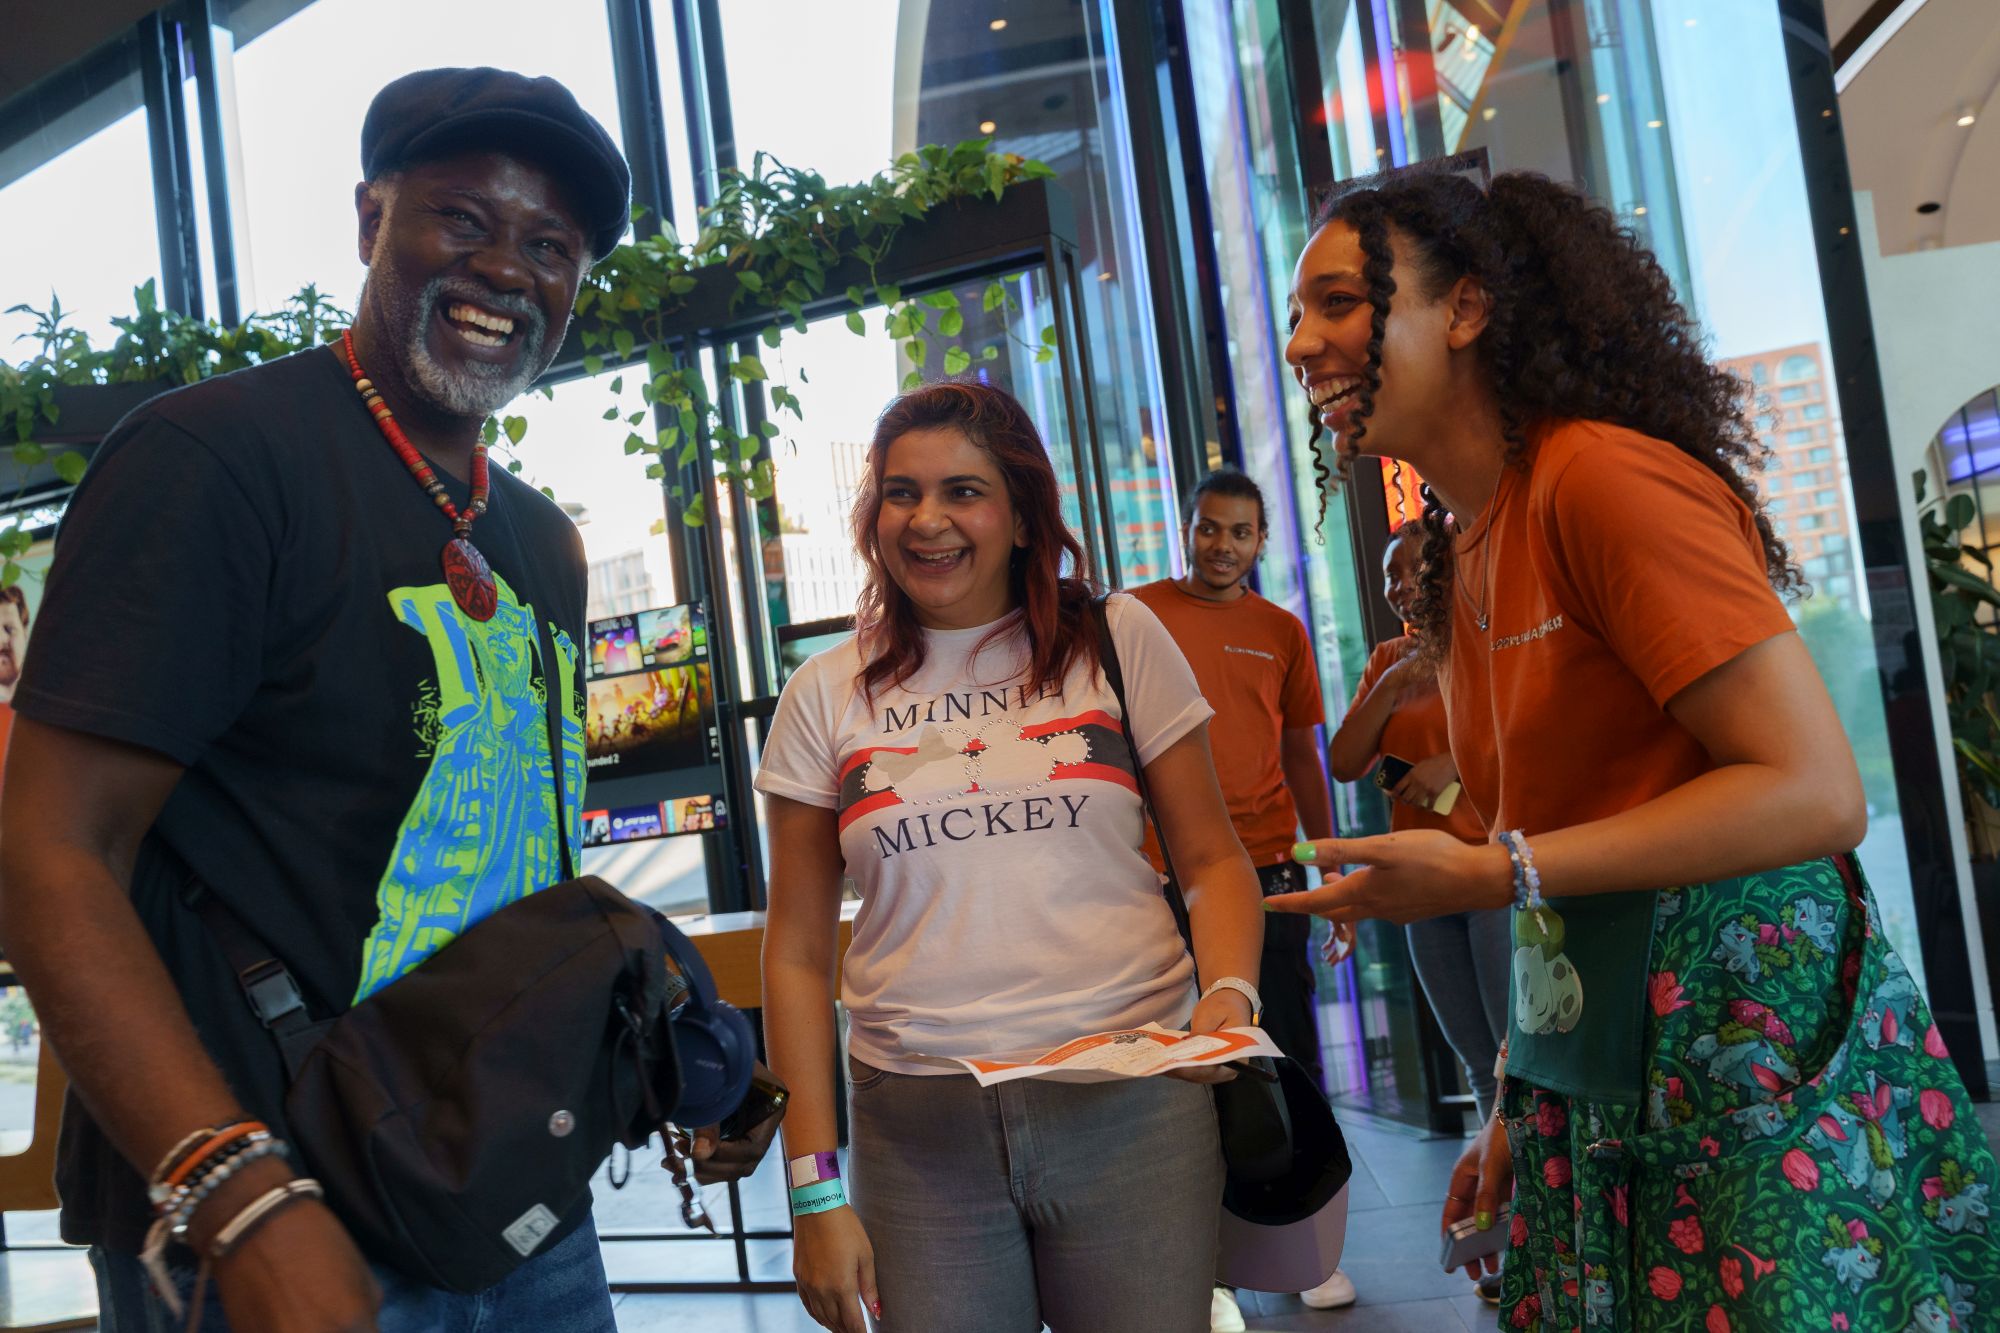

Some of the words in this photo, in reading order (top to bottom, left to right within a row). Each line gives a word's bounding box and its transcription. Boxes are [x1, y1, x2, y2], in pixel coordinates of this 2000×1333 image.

[883, 680, 1065, 733] MINNIE
[613, 753, 620, 764] 2
[871, 795, 1090, 859] MICKEY
